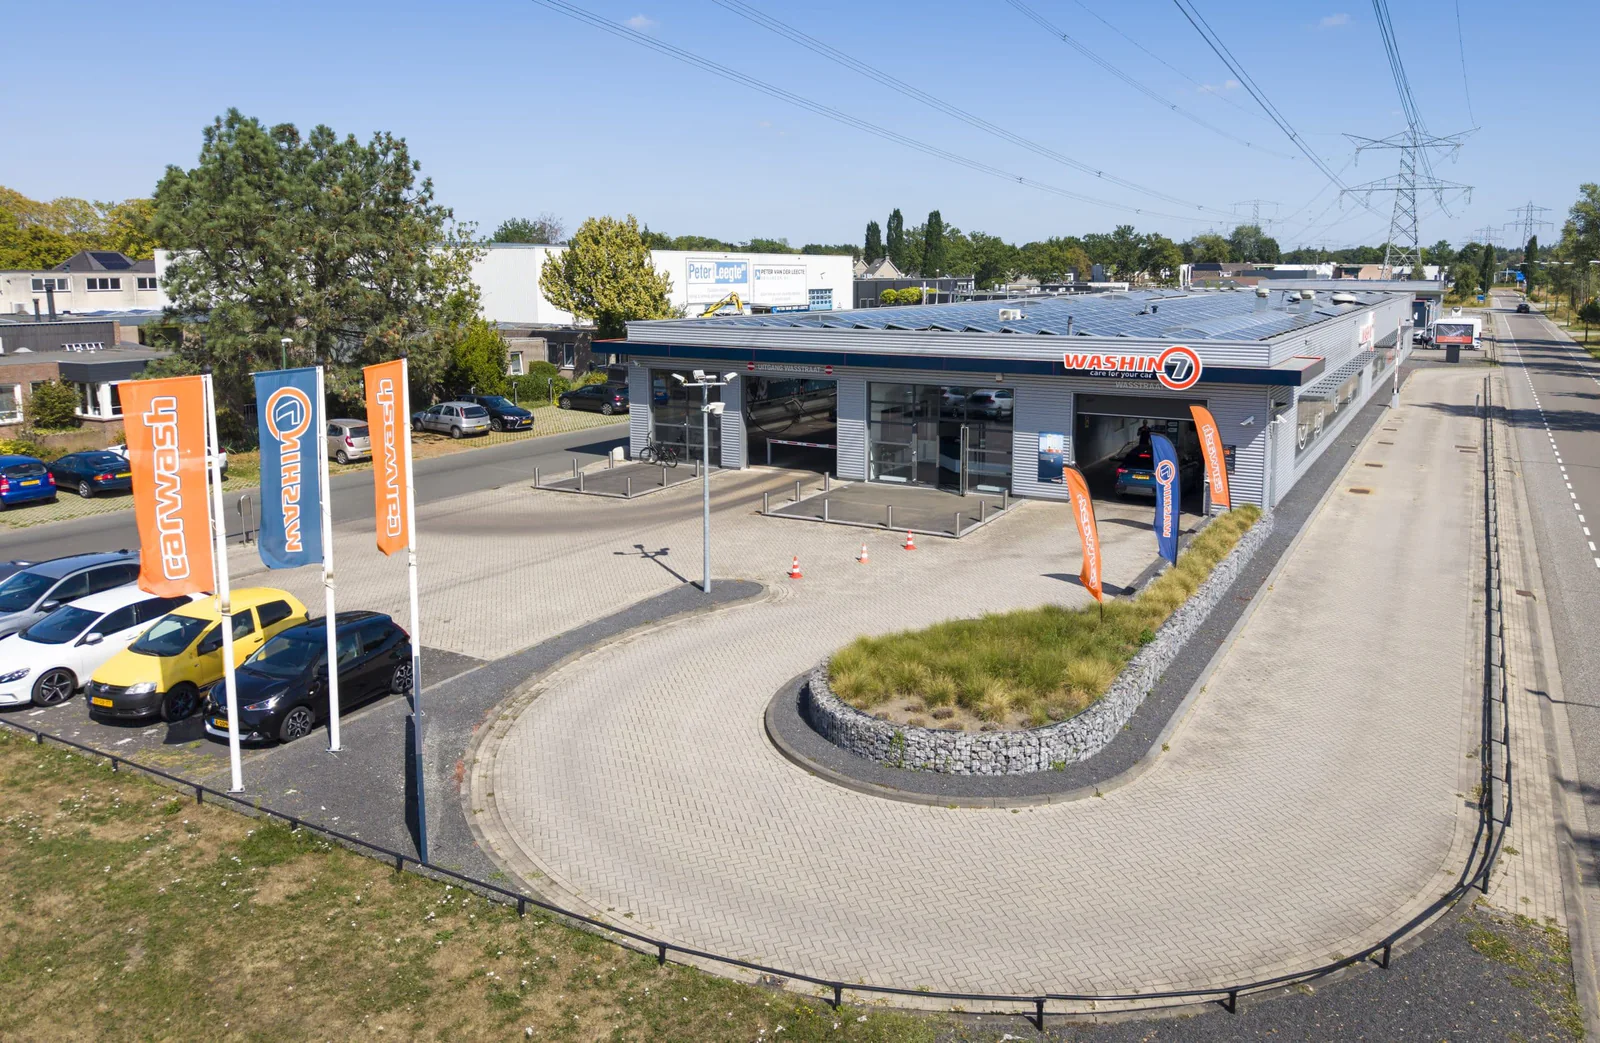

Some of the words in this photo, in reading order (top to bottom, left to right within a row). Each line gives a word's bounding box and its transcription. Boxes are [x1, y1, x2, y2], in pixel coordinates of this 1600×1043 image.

[689, 263, 711, 279] Peter
[784, 365, 821, 373] WASSTRAAT
[1063, 353, 1163, 371] WASHIN
[1108, 370, 1119, 378] for
[1120, 371, 1138, 379] your
[376, 377, 402, 538] carwash
[142, 395, 191, 581] carwash
